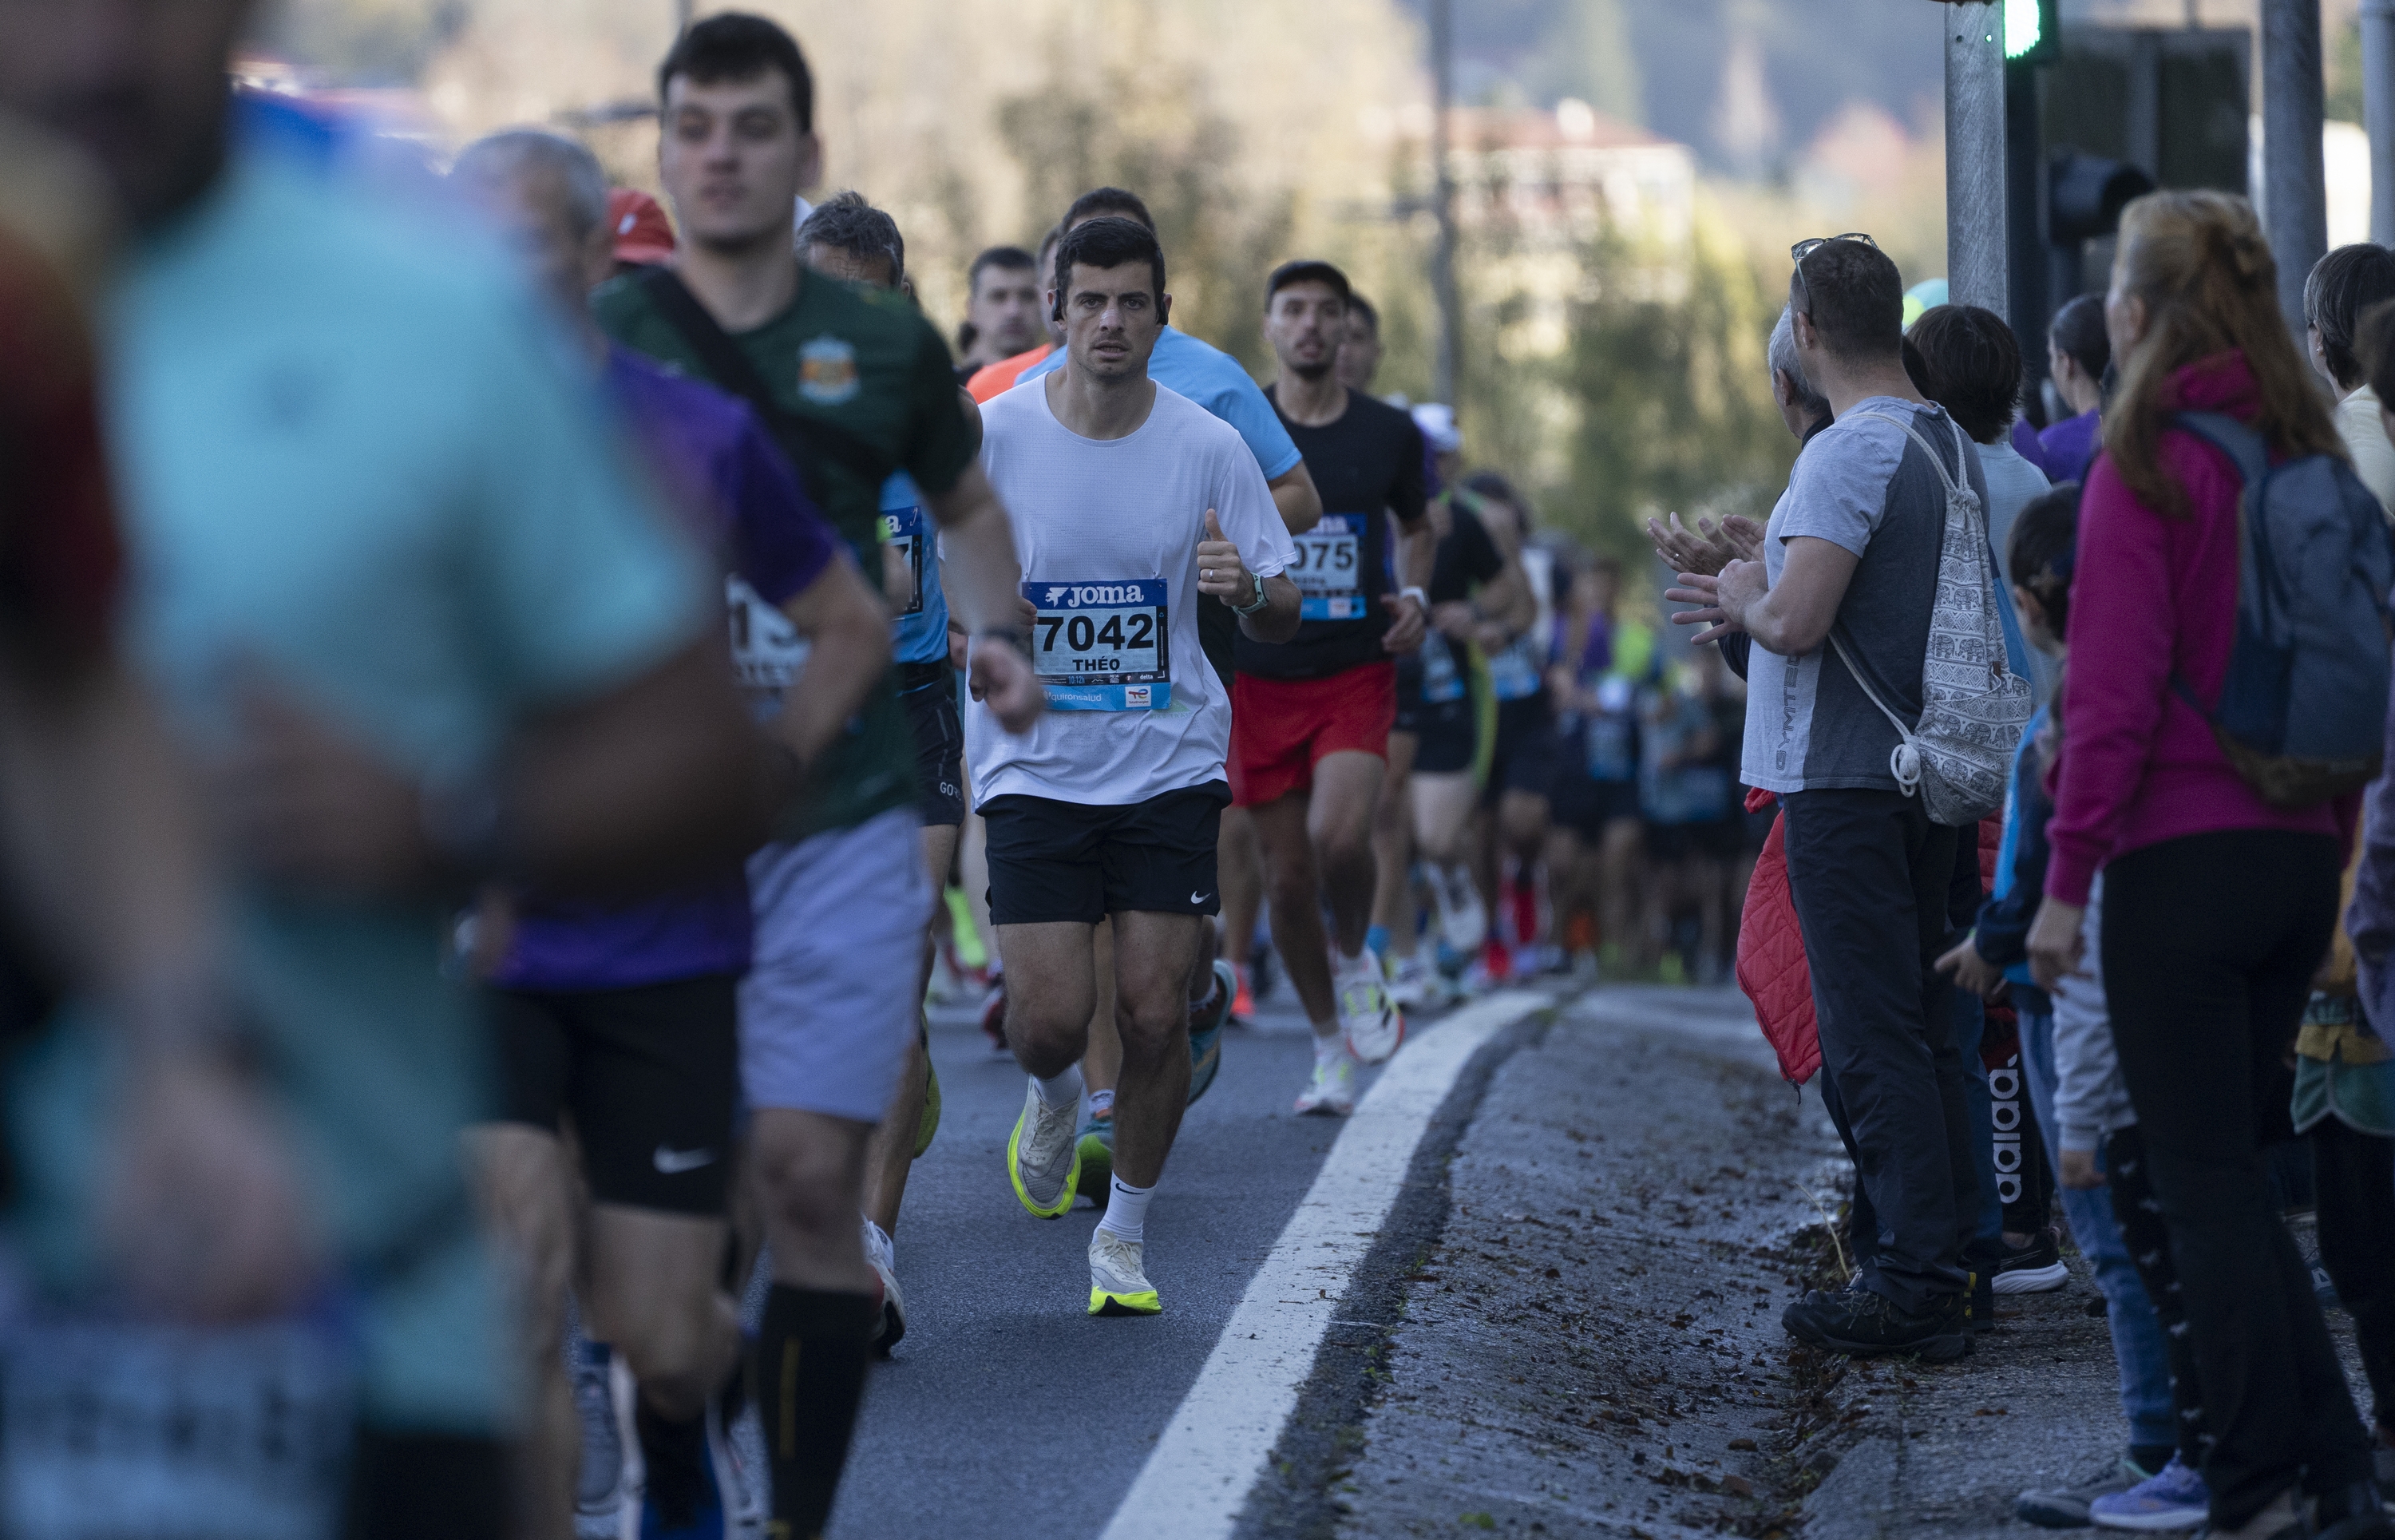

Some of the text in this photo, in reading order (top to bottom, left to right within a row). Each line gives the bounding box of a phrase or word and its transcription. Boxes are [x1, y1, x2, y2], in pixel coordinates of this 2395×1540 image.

[1038, 613, 1154, 652] 7042
[1072, 656, 1120, 671] THÉO
[1989, 1054, 2022, 1204] adida
